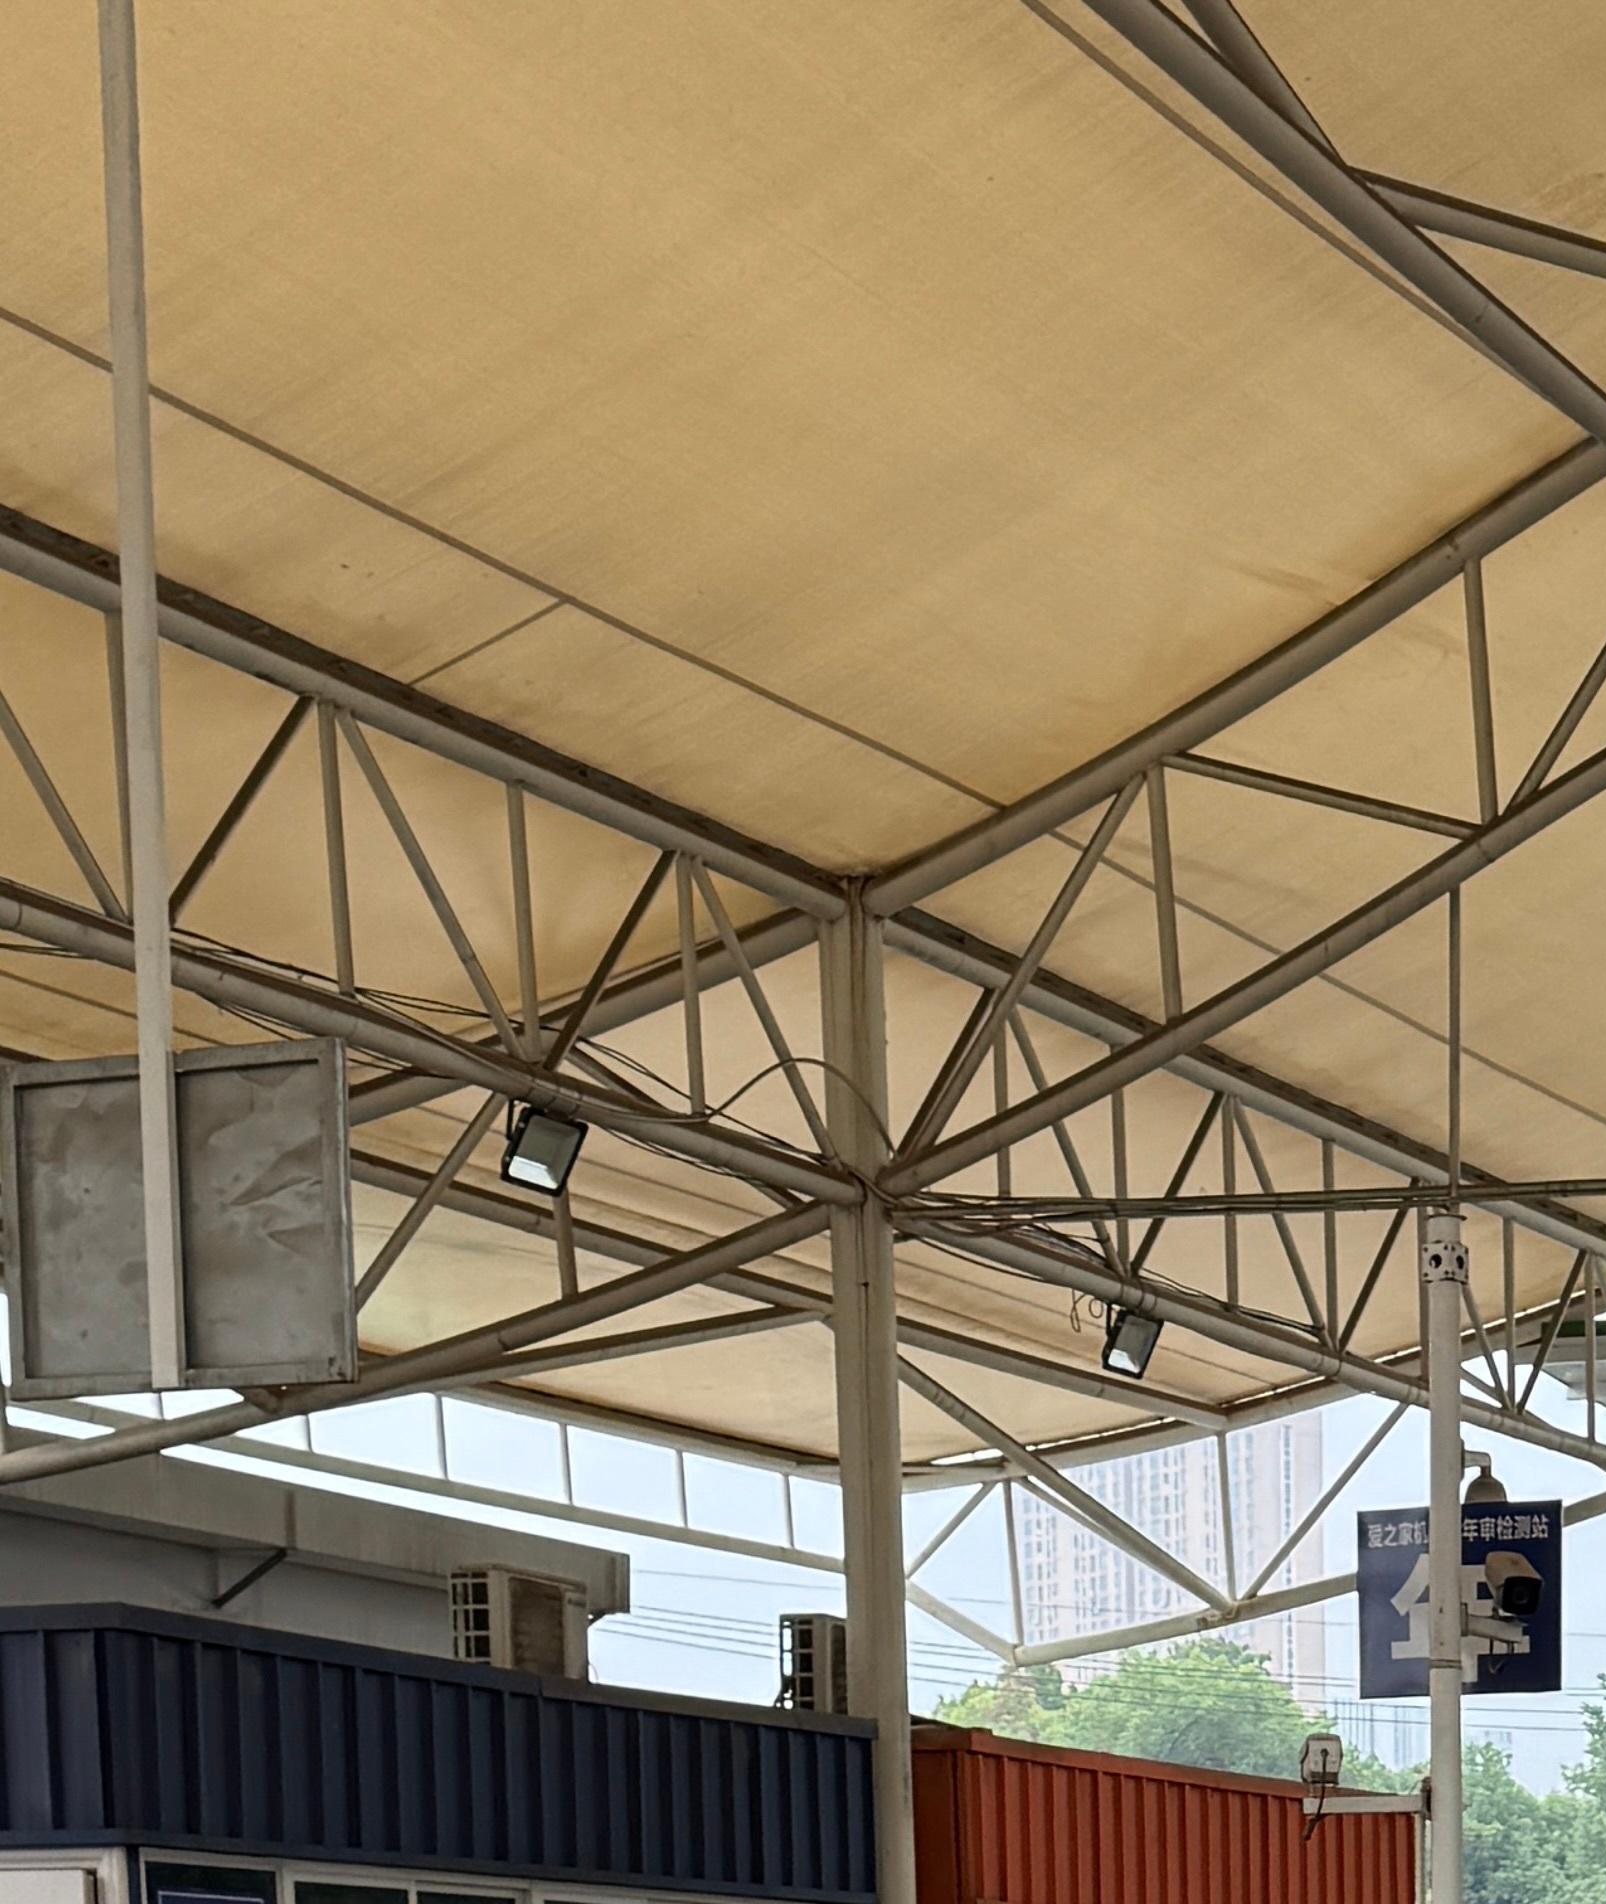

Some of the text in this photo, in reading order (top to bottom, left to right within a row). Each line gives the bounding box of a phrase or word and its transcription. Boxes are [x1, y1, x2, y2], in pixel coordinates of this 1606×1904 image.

[1367, 1514, 1549, 1548] 爱之家机年审检测站
